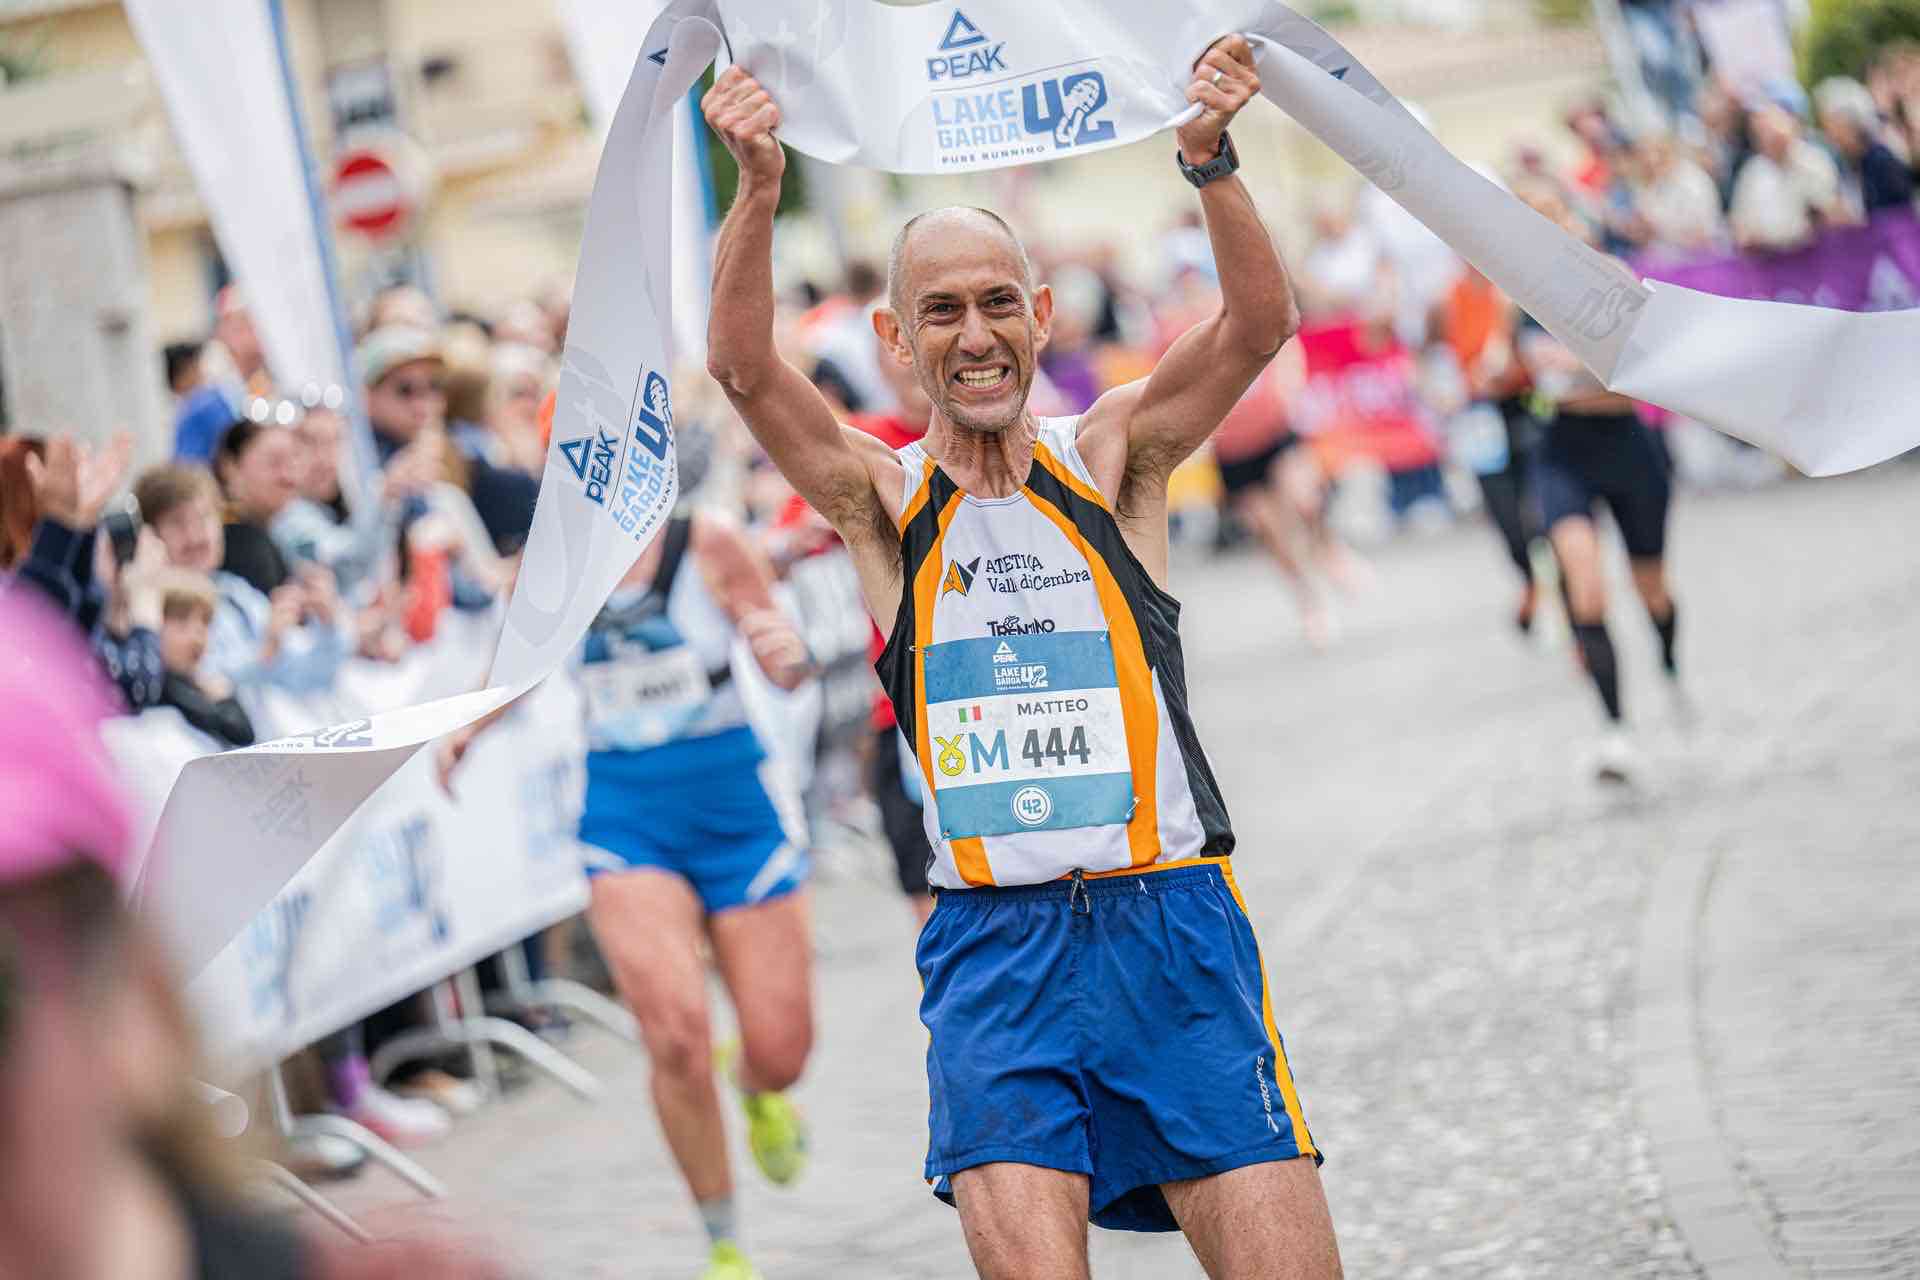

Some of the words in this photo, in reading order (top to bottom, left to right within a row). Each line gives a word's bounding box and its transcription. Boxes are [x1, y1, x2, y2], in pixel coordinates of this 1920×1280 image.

[927, 41, 1008, 81] PEAK
[931, 89, 1019, 126] LAKE
[1021, 71, 1117, 150] 42
[937, 124, 1022, 149] GARDA
[942, 154, 977, 164] PURE
[982, 145, 1046, 160] RUNNING
[584, 424, 620, 505] PEAK
[611, 447, 653, 523] LAKE
[620, 463, 666, 534] GARDA
[987, 577, 1019, 593] Vall
[994, 666, 1020, 678] LAKE
[1017, 698, 1089, 716] MATTEO
[968, 728, 1010, 774] M
[1022, 725, 1091, 768] 444
[1021, 798, 1043, 815] 42
